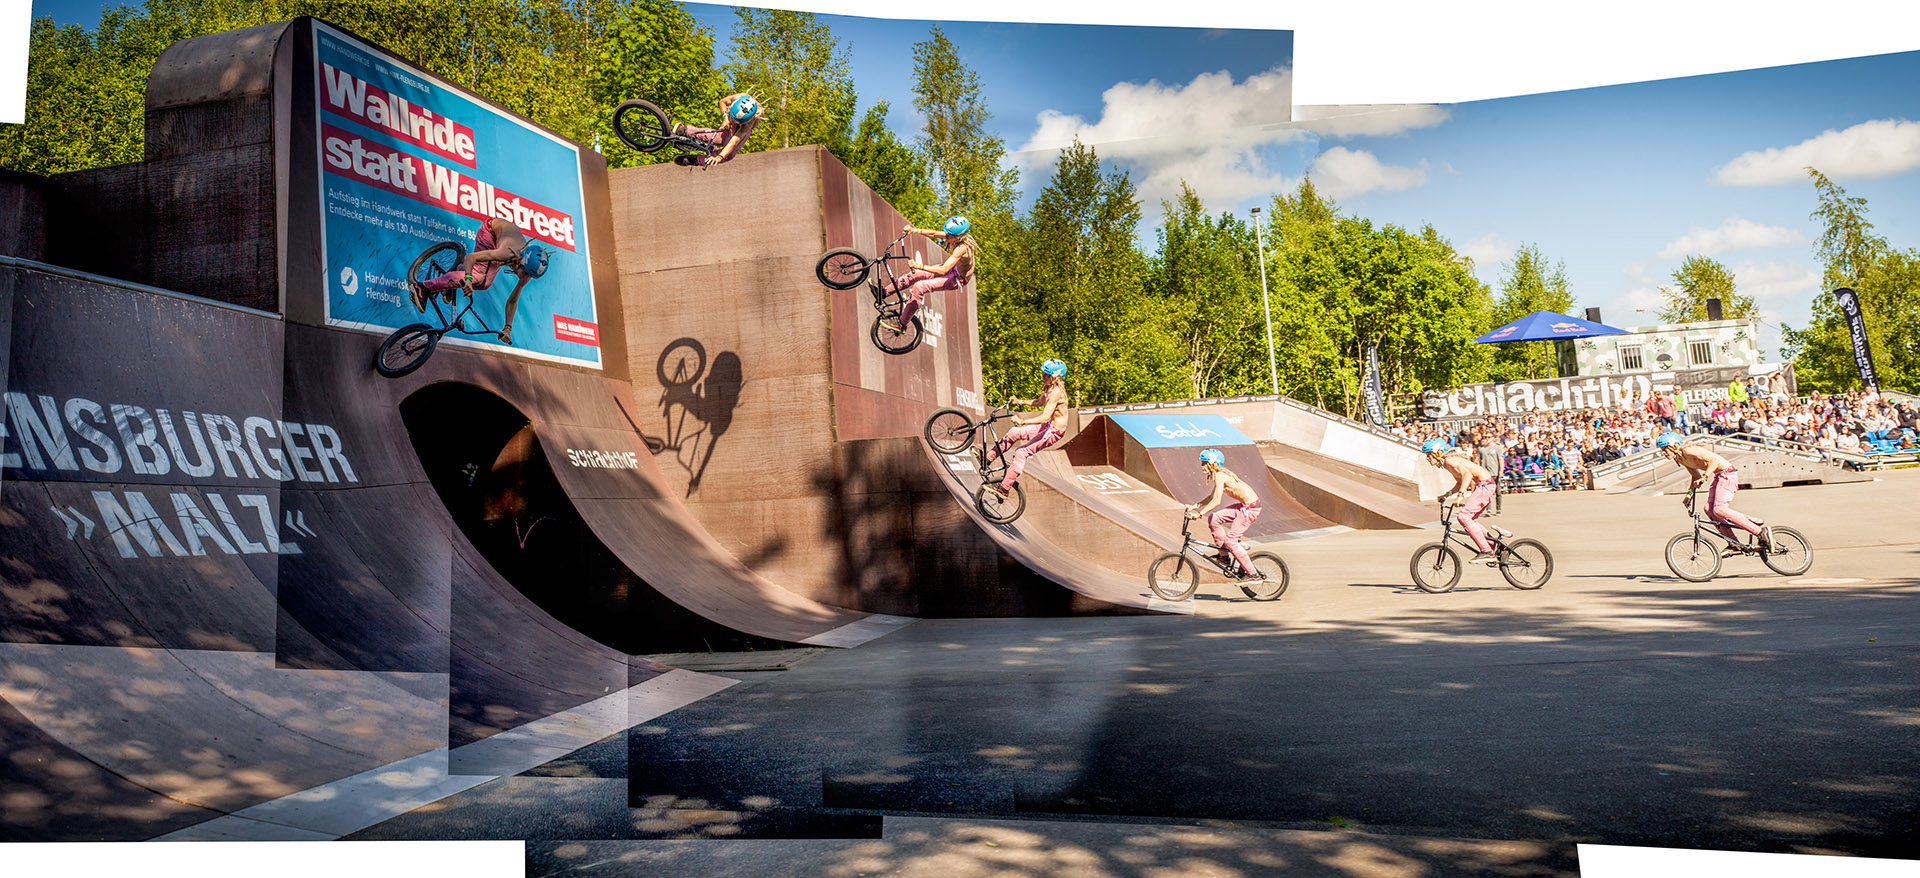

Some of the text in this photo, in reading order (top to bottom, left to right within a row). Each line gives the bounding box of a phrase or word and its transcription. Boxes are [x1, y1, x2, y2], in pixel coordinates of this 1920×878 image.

[322, 64, 476, 161] Wallride
[325, 136, 575, 246] statt Wallstreet
[328, 187, 359, 208] Aufstieg
[361, 197, 371, 209] im
[372, 200, 406, 219] Handwerk
[407, 212, 422, 224] statt
[423, 215, 447, 232] Talfahrt
[448, 224, 456, 233] an
[457, 226, 467, 237] der
[329, 202, 363, 222] Entdecke
[364, 215, 383, 227] mehr
[384, 219, 395, 231] als
[396, 222, 409, 234] 130
[365, 270, 410, 292] Handwerksk
[365, 287, 401, 308] Flensburg
